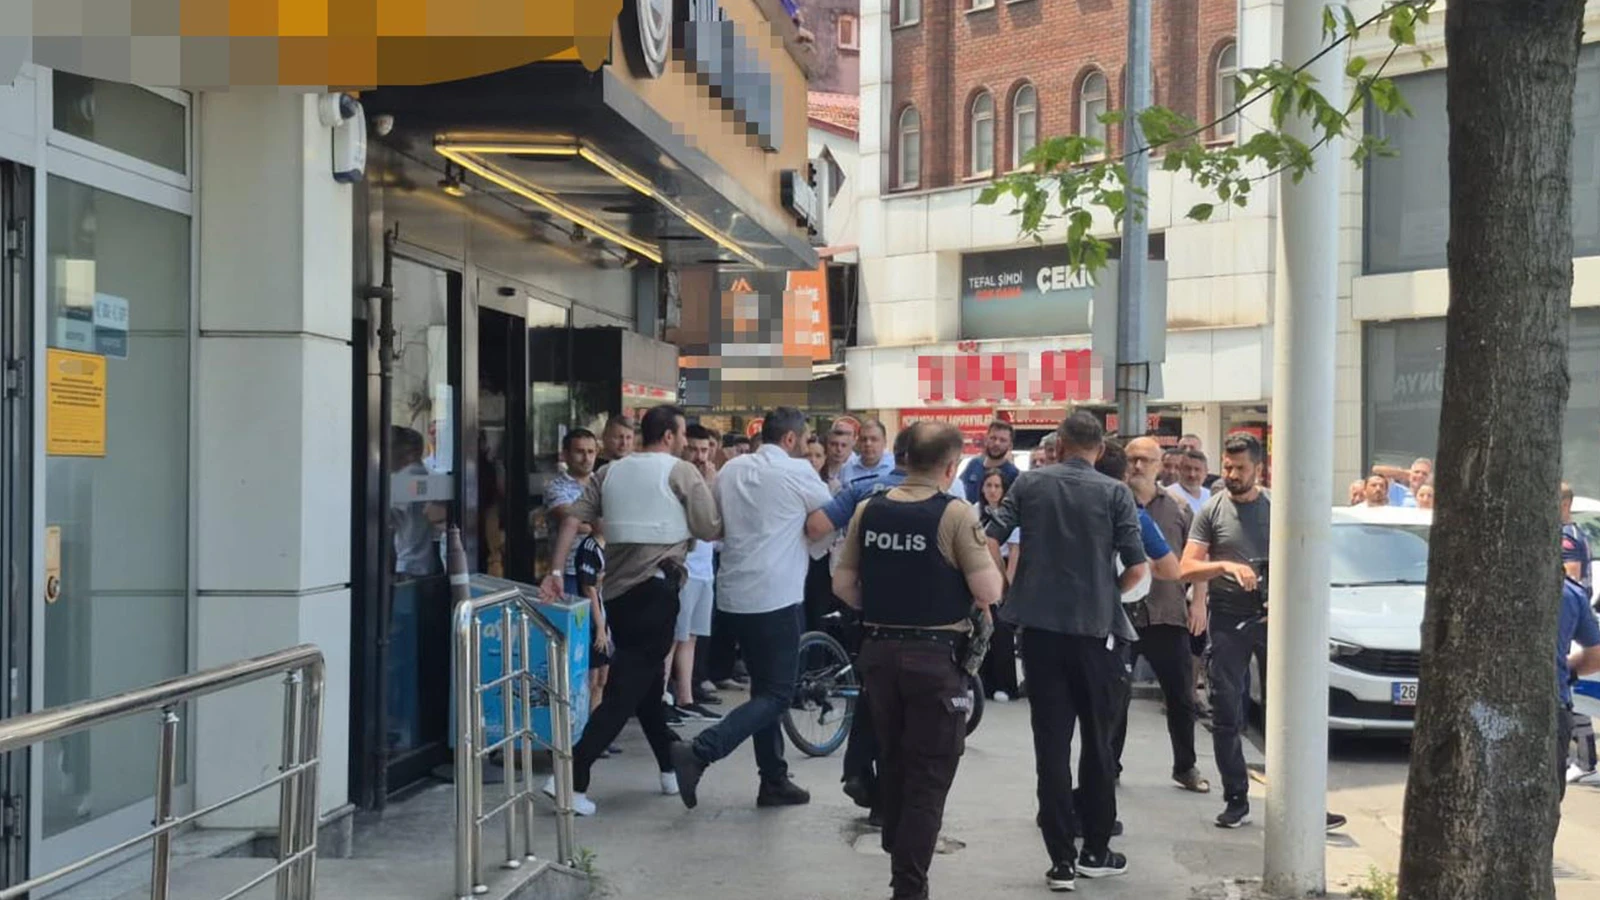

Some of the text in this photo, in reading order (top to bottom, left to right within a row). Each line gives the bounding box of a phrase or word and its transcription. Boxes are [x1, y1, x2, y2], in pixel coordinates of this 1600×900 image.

[968, 270, 1023, 289] TEFAL ŞİMDİ
[864, 530, 927, 551] POLİS
[1401, 685, 1416, 699] 26
